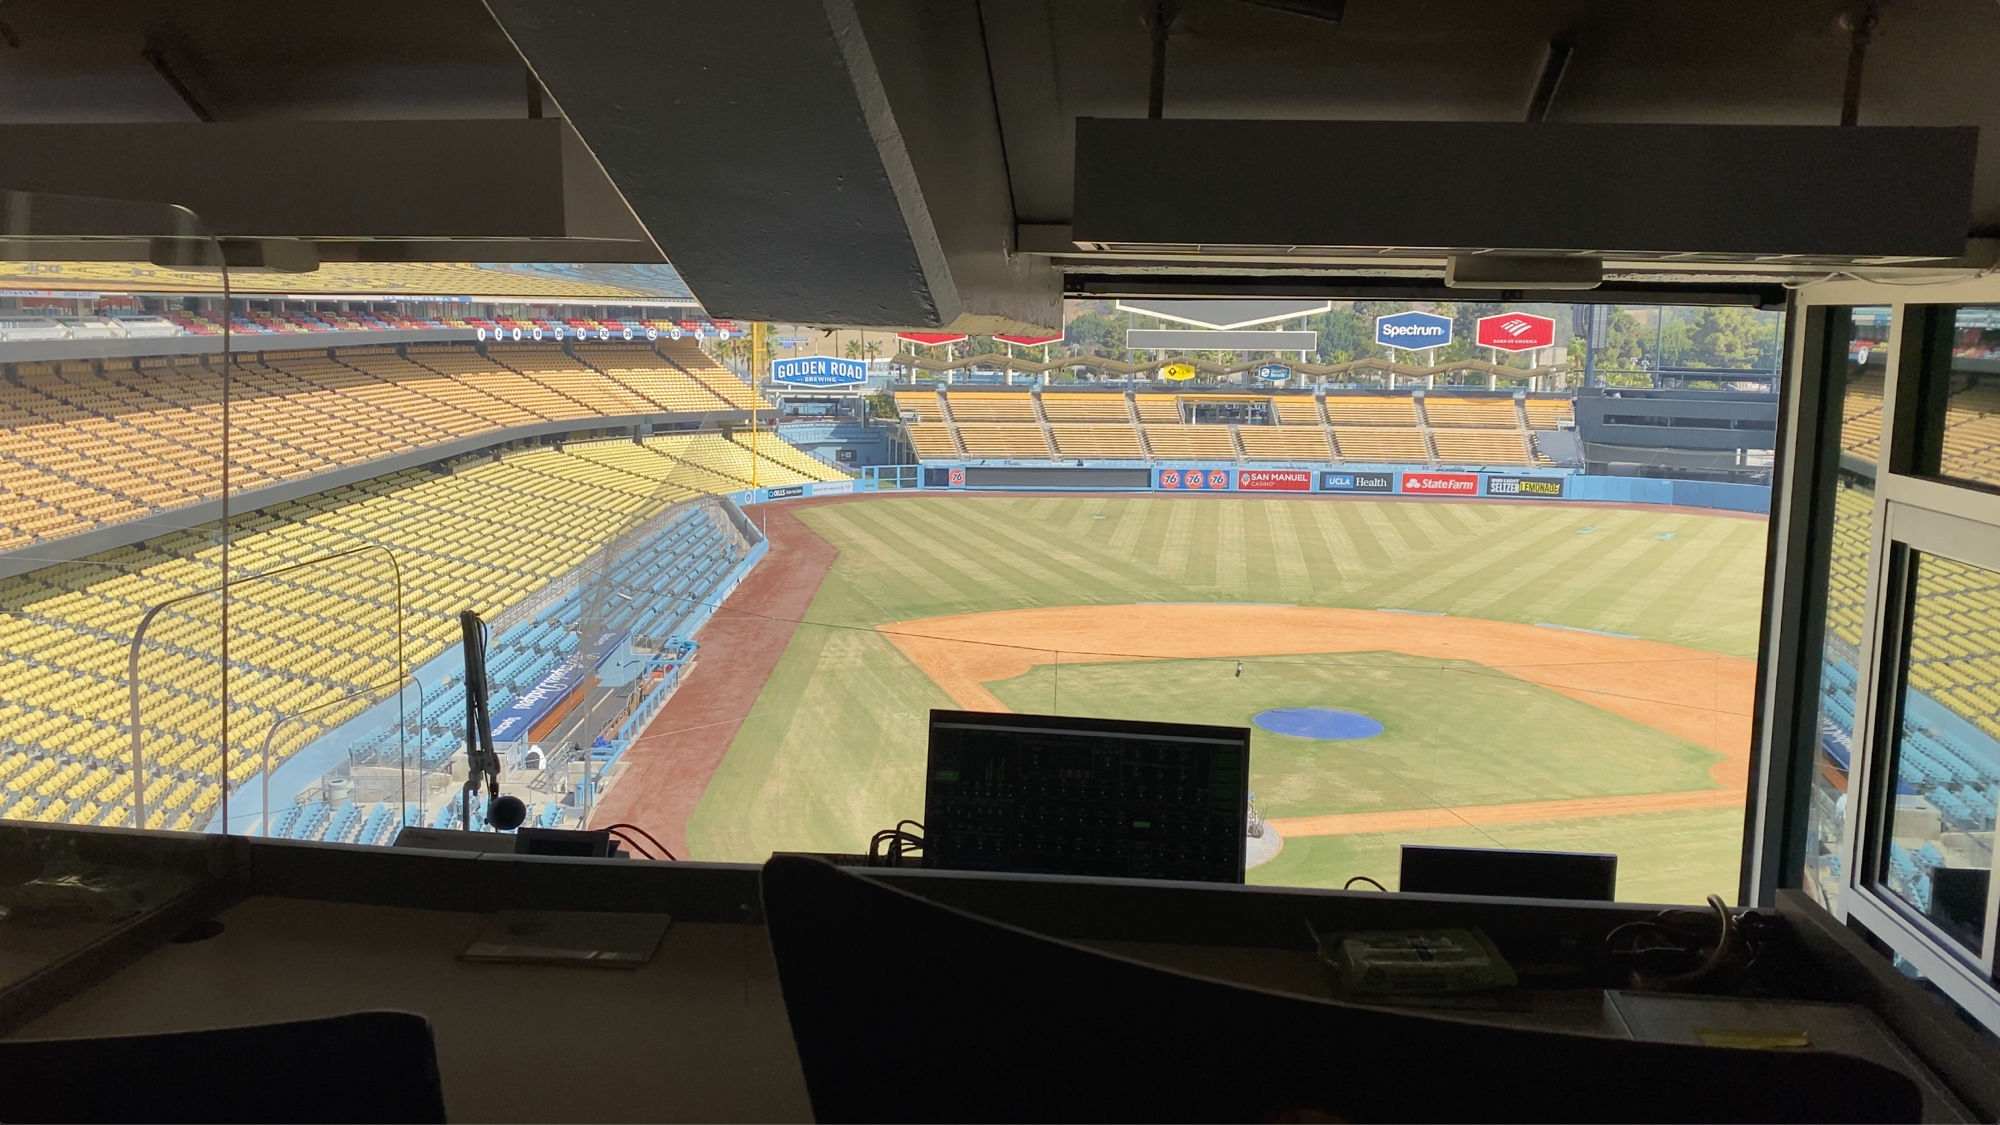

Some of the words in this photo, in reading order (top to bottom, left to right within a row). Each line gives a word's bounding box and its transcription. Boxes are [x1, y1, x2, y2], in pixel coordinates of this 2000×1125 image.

[1382, 324, 1442, 338] Spectrum
[778, 361, 826, 378] GOLDEN
[831, 361, 862, 379] ROAD
[951, 472, 963, 482] 76
[1164, 474, 1177, 484] 76
[1188, 474, 1201, 484] 76
[1211, 474, 1224, 484] 76
[1251, 473, 1270, 481] SAN
[1271, 474, 1308, 482] MANUEL
[1355, 477, 1388, 488] Health
[1490, 482, 1520, 493] SELTZER
[1520, 481, 1560, 494] LEMONADE
